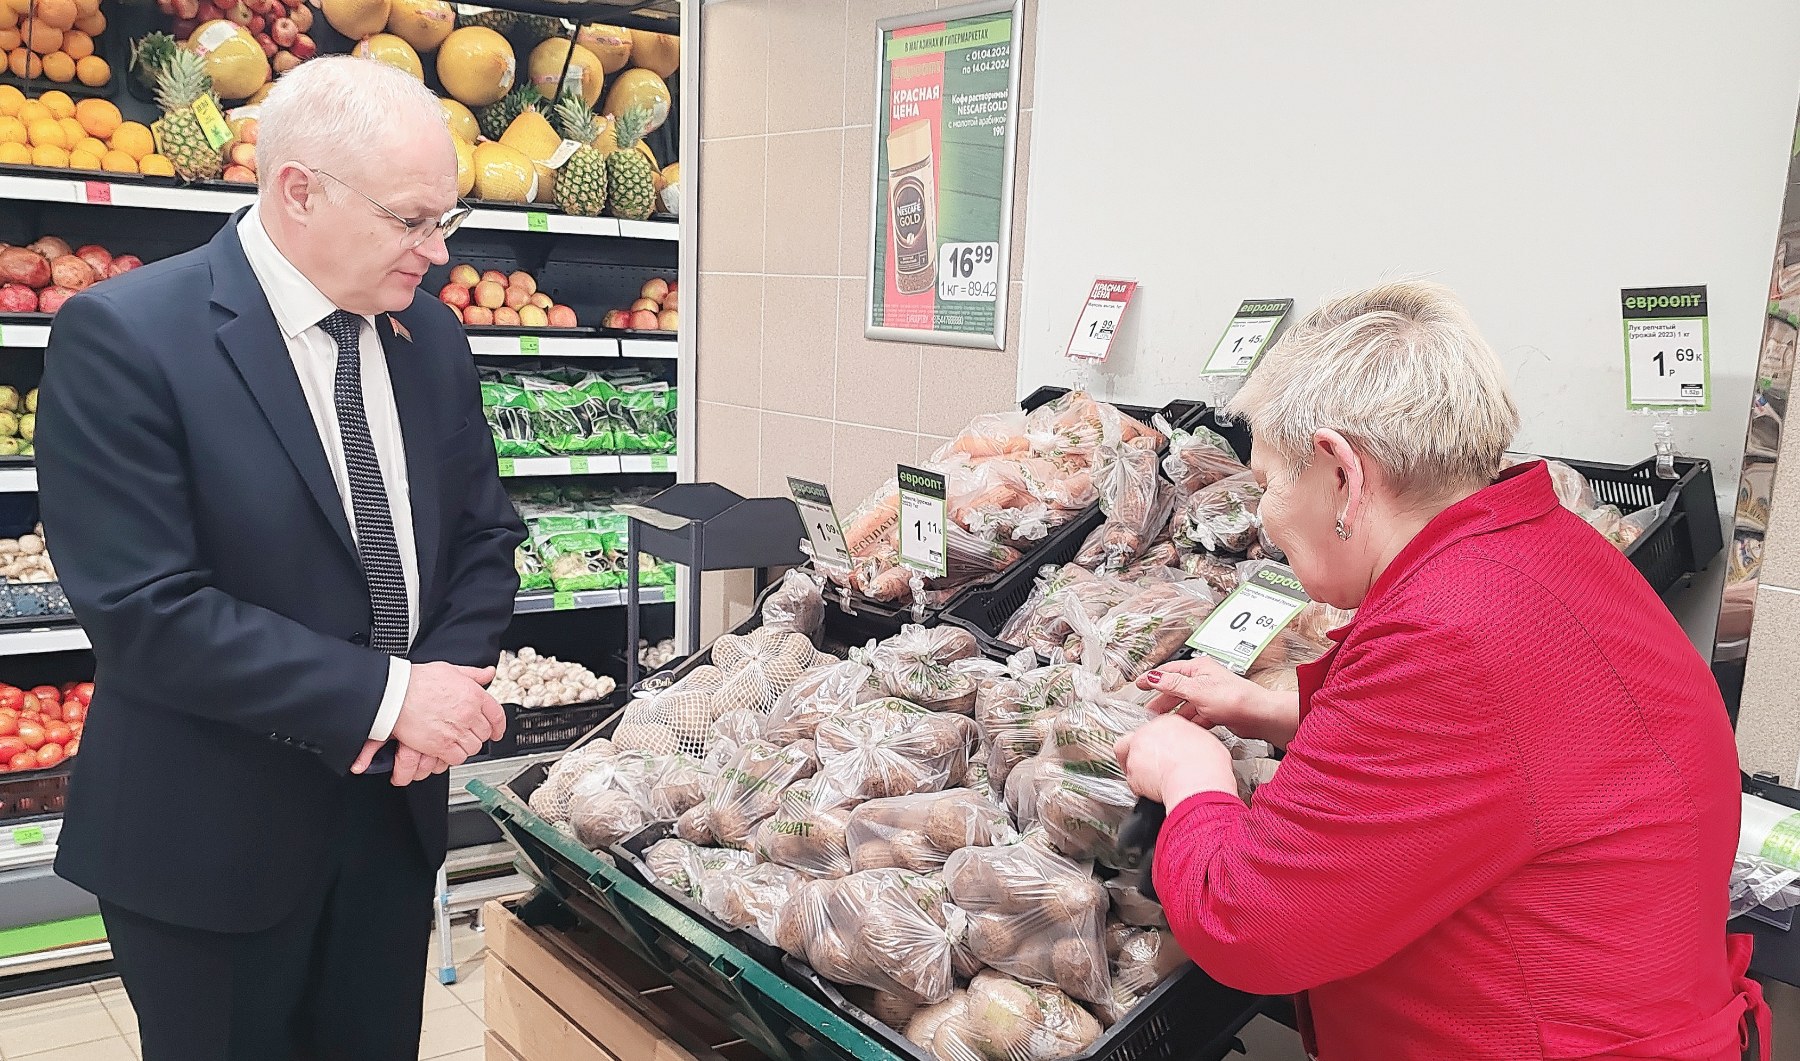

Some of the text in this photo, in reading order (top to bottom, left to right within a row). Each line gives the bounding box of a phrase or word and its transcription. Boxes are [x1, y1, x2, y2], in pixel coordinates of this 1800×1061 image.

[904, 28, 989, 53] В МАГАЗИНАХ И ГИПЕРМАРКЕТАХ
[972, 45, 1010, 61] 01.04.2024
[962, 58, 1010, 75] по 14.04.2024
[893, 84, 940, 104] КРАСНАЯ
[952, 93, 968, 106] Кофе
[892, 102, 920, 120] ЦЕНА
[957, 100, 1008, 116] NESCAFE GOLD
[900, 213, 920, 227] GOLD
[941, 281, 946, 296] 1
[947, 285, 959, 296] кг
[968, 281, 998, 298] 89.42
[1090, 290, 1110, 300] ЦЕНА
[1094, 283, 1127, 293] КРАСНАЯ
[1240, 303, 1287, 314] евроопт
[1625, 294, 1702, 312] евроопт
[1089, 320, 1098, 338] 1
[1102, 320, 1113, 330] 99
[1642, 324, 1676, 332] репчатый
[1232, 336, 1244, 354] 1
[1248, 334, 1262, 344] 45
[1652, 350, 1665, 377] 1
[1676, 348, 1694, 362] 69
[900, 471, 943, 491] евроопт
[816, 522, 826, 542] 1
[914, 520, 921, 542] 1
[928, 521, 937, 534] 11
[1230, 612, 1252, 630] 0
[1256, 616, 1274, 628] 69
